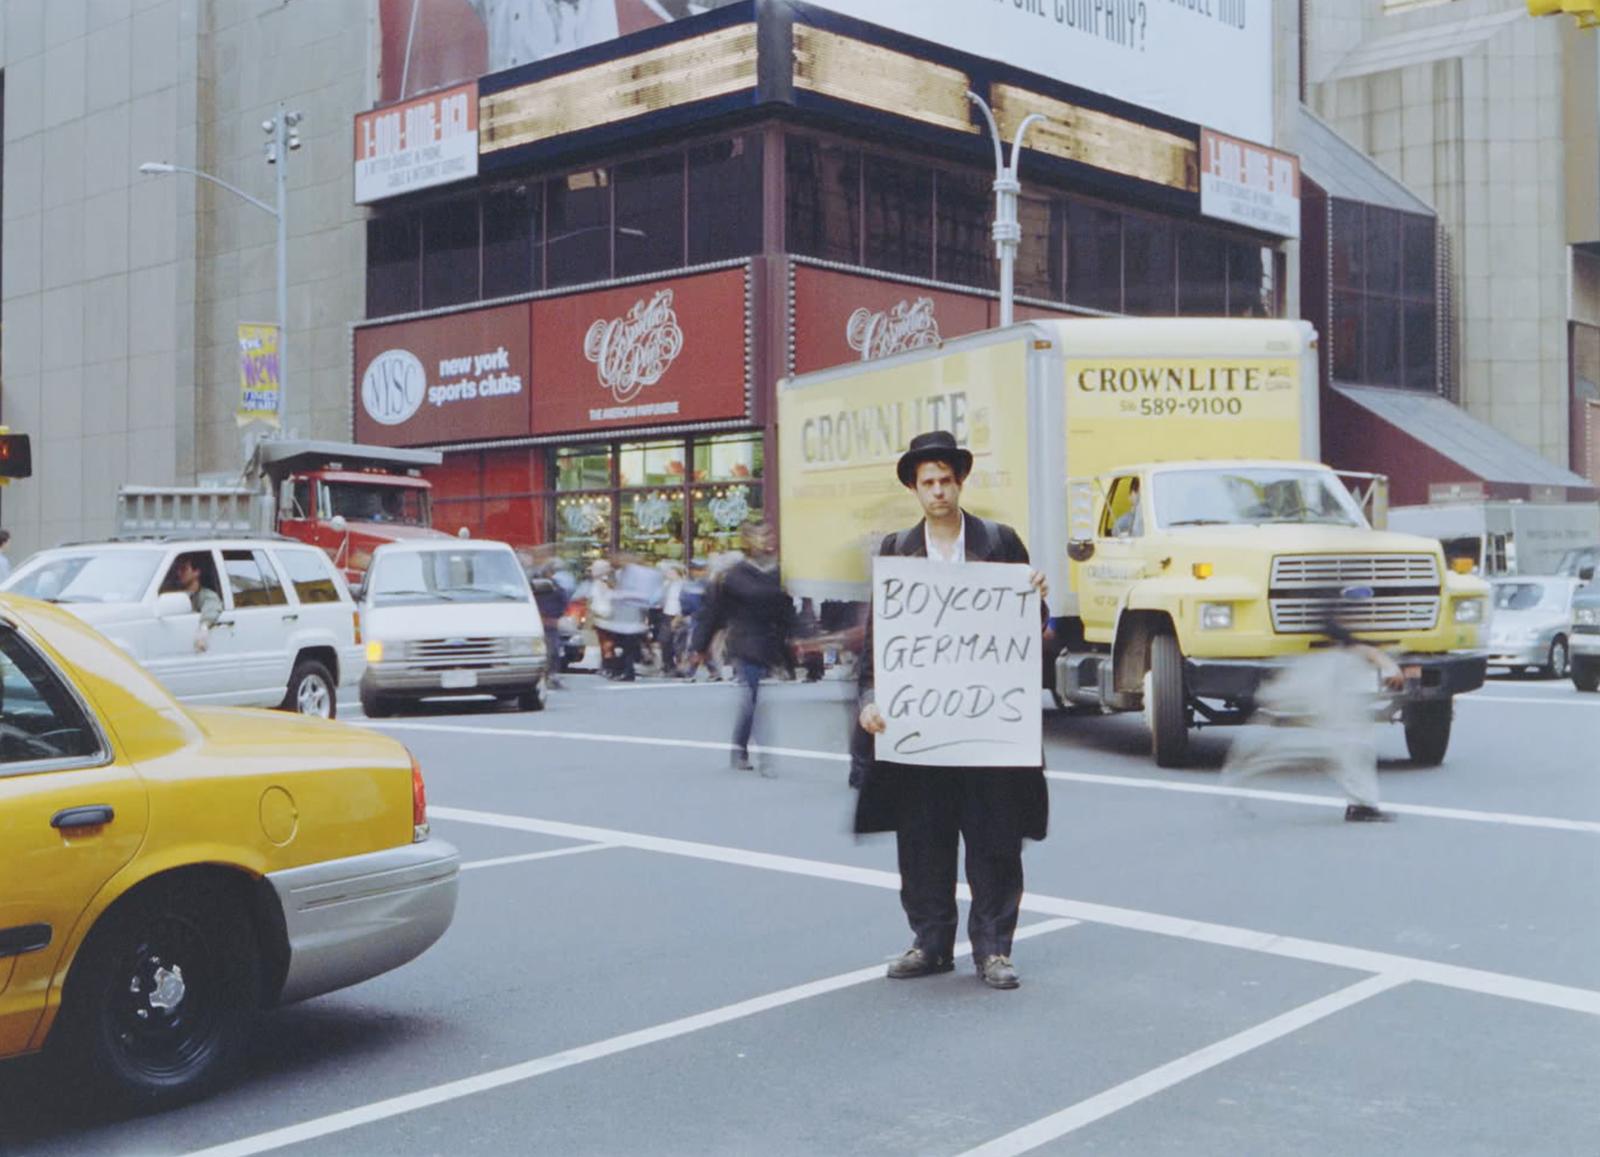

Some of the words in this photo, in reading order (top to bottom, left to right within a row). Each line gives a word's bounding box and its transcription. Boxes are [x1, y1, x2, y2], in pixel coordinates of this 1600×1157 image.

[439, 356, 473, 377] new
[474, 346, 509, 376] york
[428, 378, 477, 407] sports
[479, 373, 522, 397] clubs
[1078, 367, 1260, 393] CROWNLITE
[1140, 397, 1242, 416] 589-9100
[879, 578, 1036, 628] BOYCOTT
[883, 633, 1031, 672] GERMAN
[888, 685, 1025, 722] GOODS
